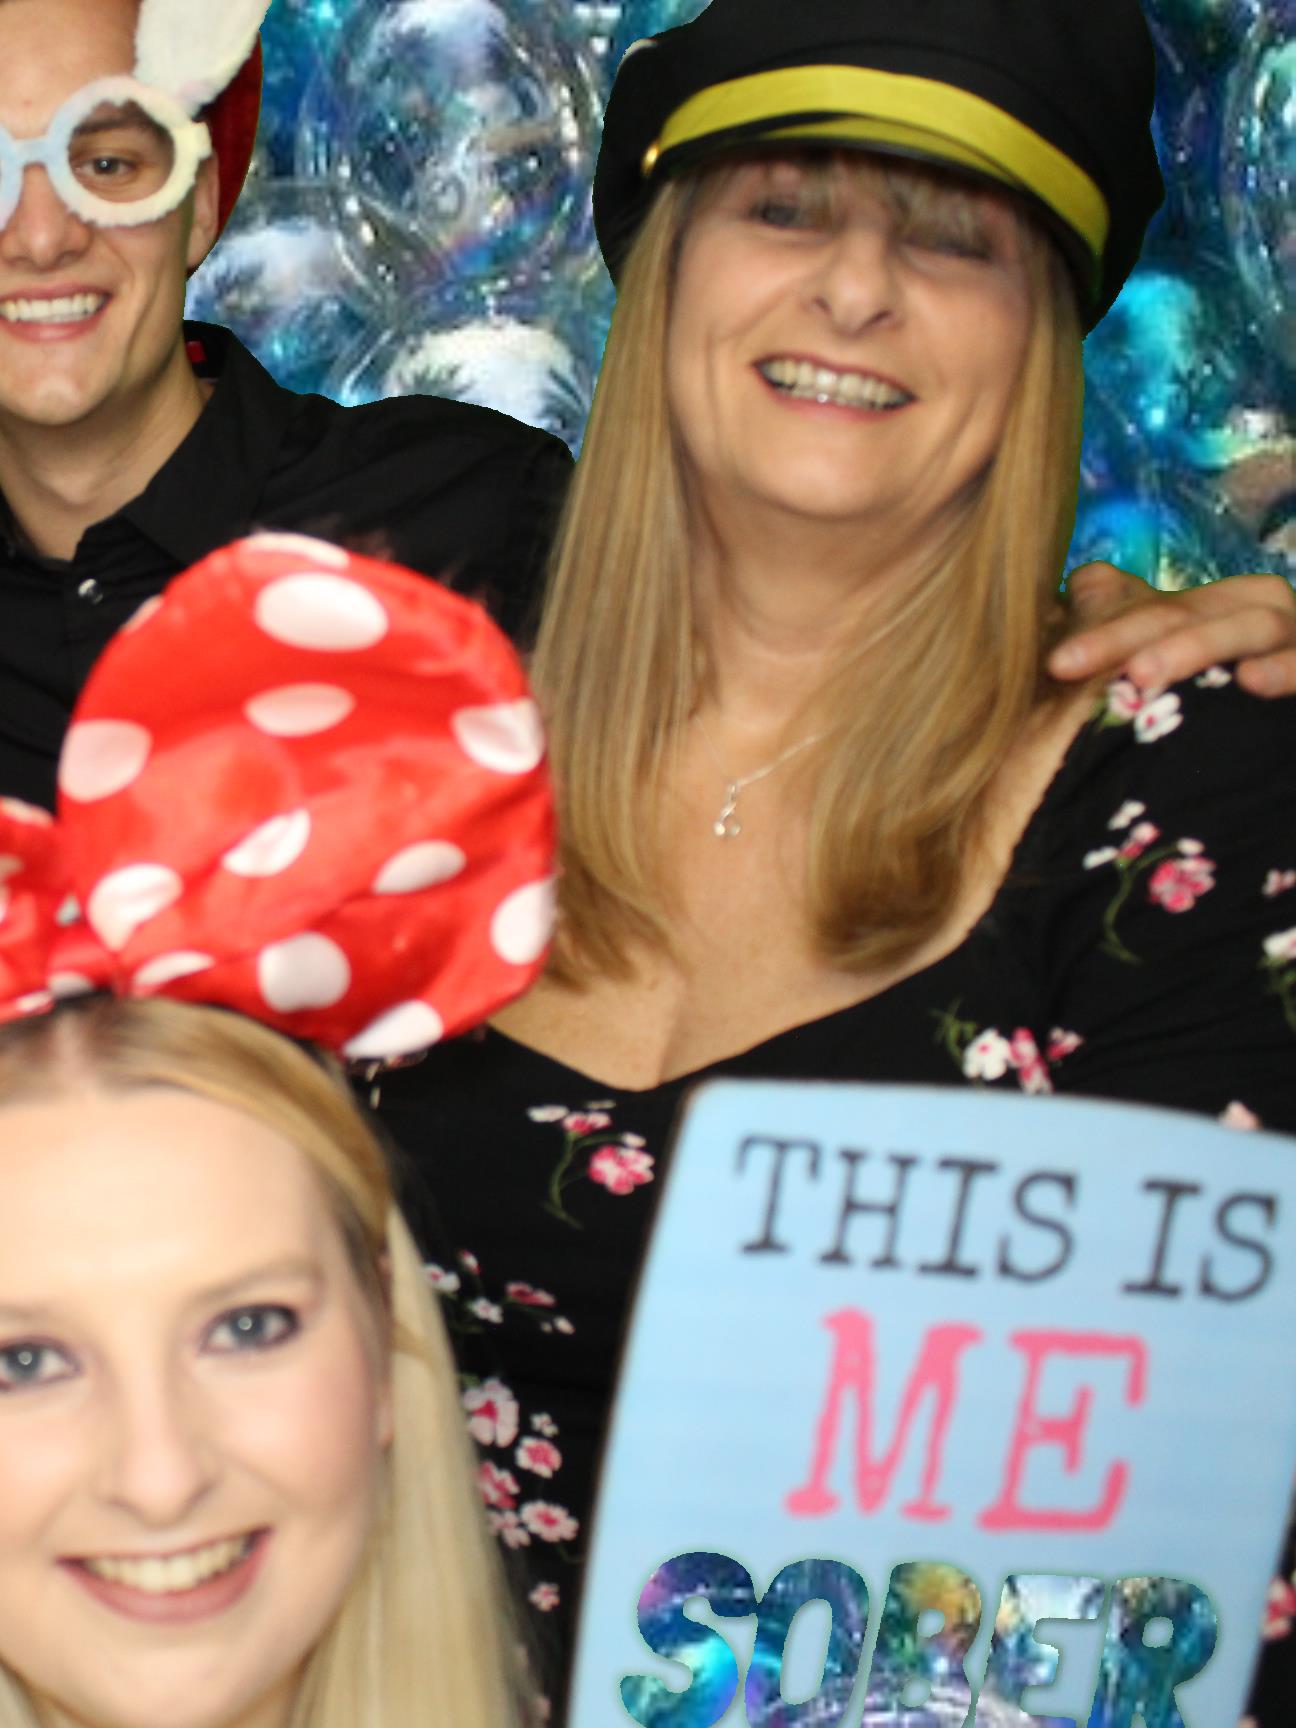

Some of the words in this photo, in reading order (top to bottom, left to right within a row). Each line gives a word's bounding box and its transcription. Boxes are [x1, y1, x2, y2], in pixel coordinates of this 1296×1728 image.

[736, 1134, 1080, 1284] THIS
[1119, 1176, 1278, 1303] IS
[783, 1306, 1150, 1533] ME
[619, 1551, 1218, 1728] SOBER
